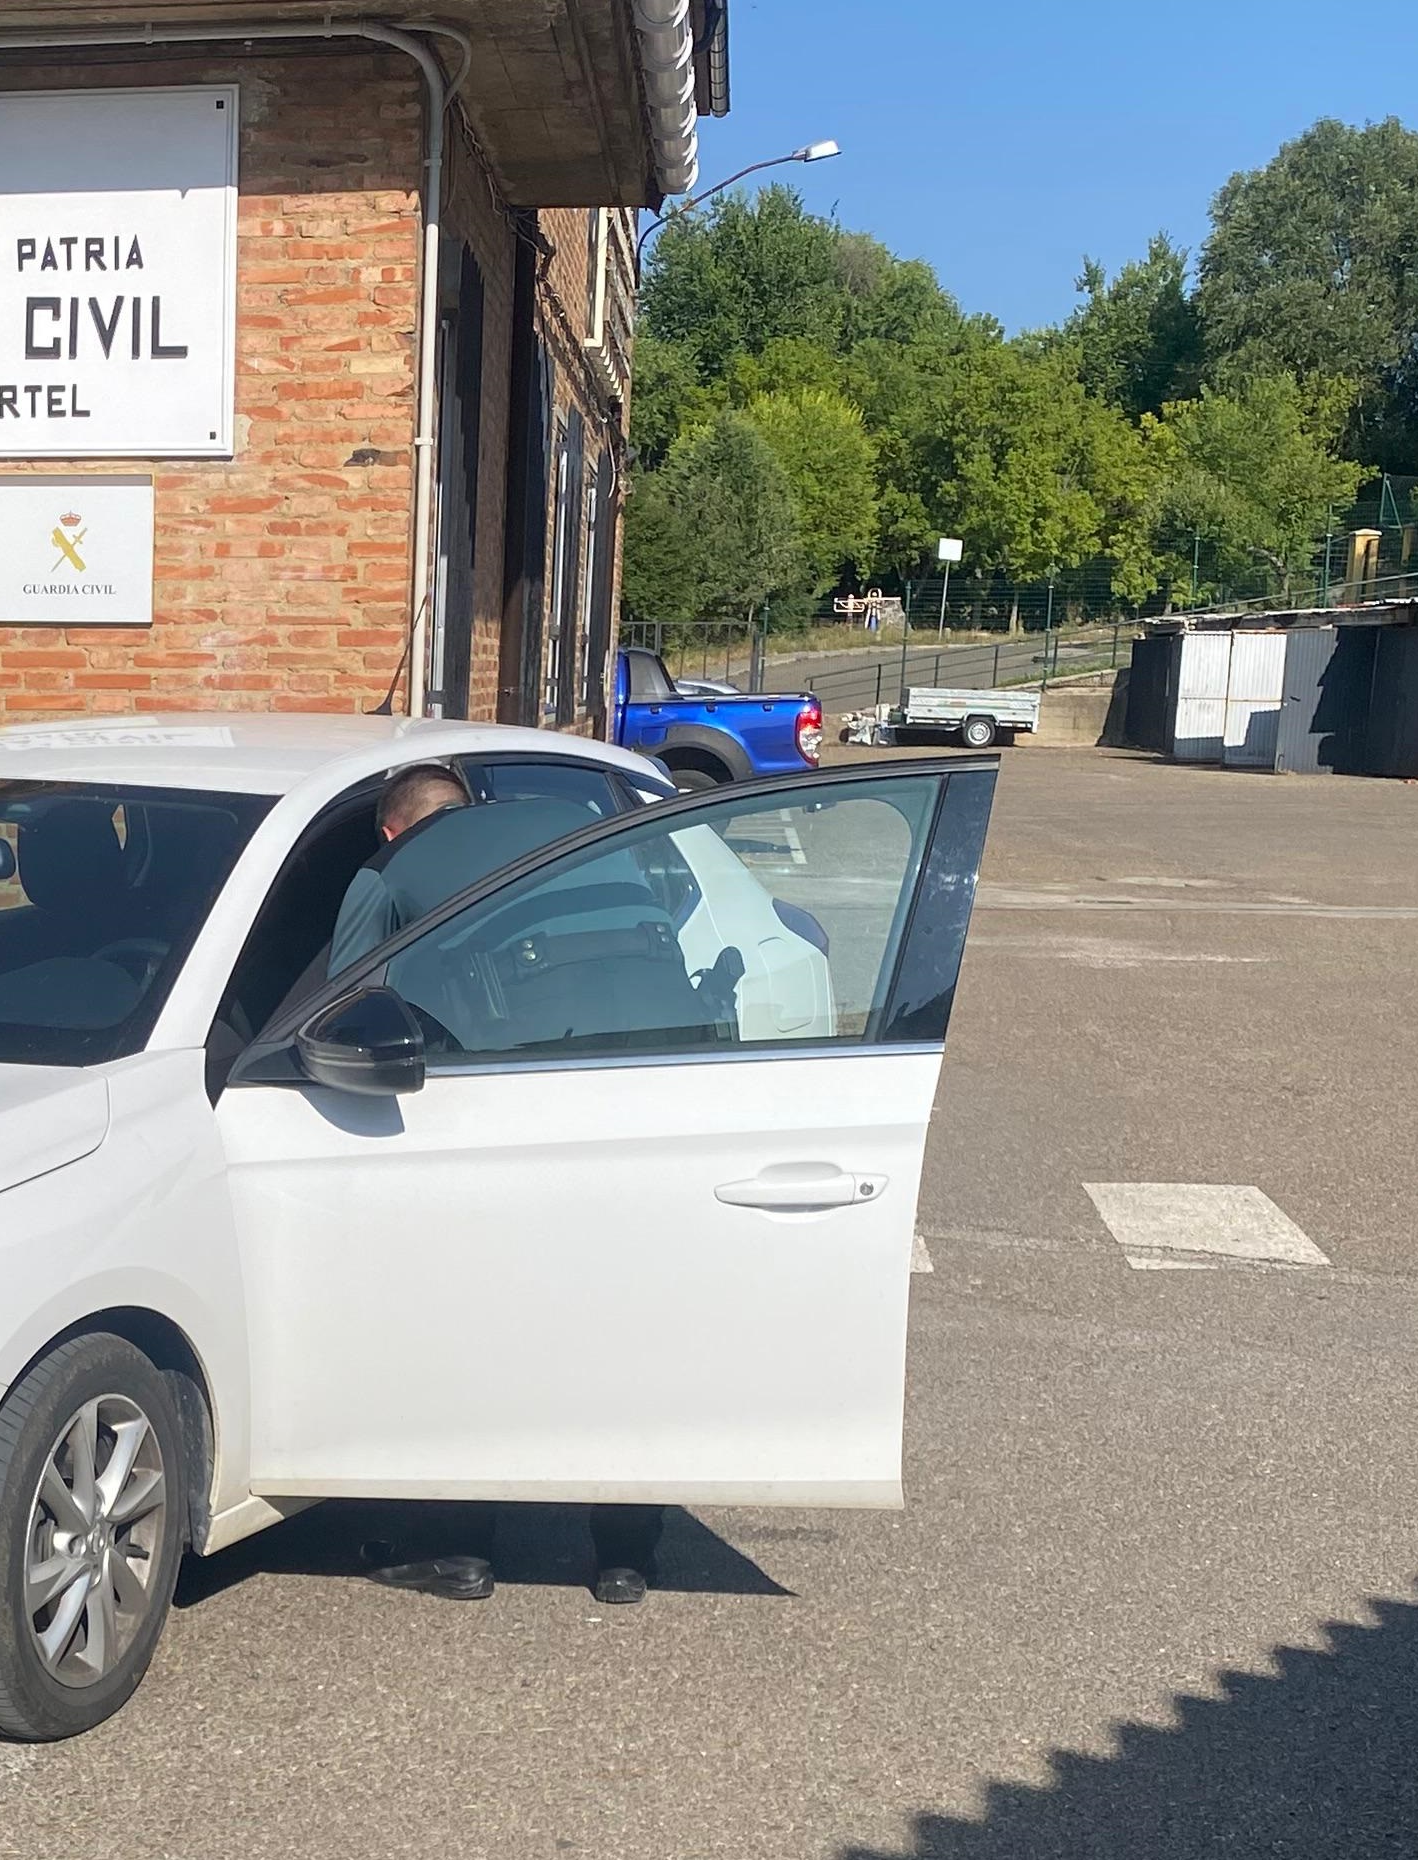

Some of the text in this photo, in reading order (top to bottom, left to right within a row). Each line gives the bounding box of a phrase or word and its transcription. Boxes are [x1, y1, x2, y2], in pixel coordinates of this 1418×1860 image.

[18, 235, 143, 271] PATRIA
[25, 296, 187, 359] CIVIL
[22, 584, 118, 596] GUARDIA CIVIL
